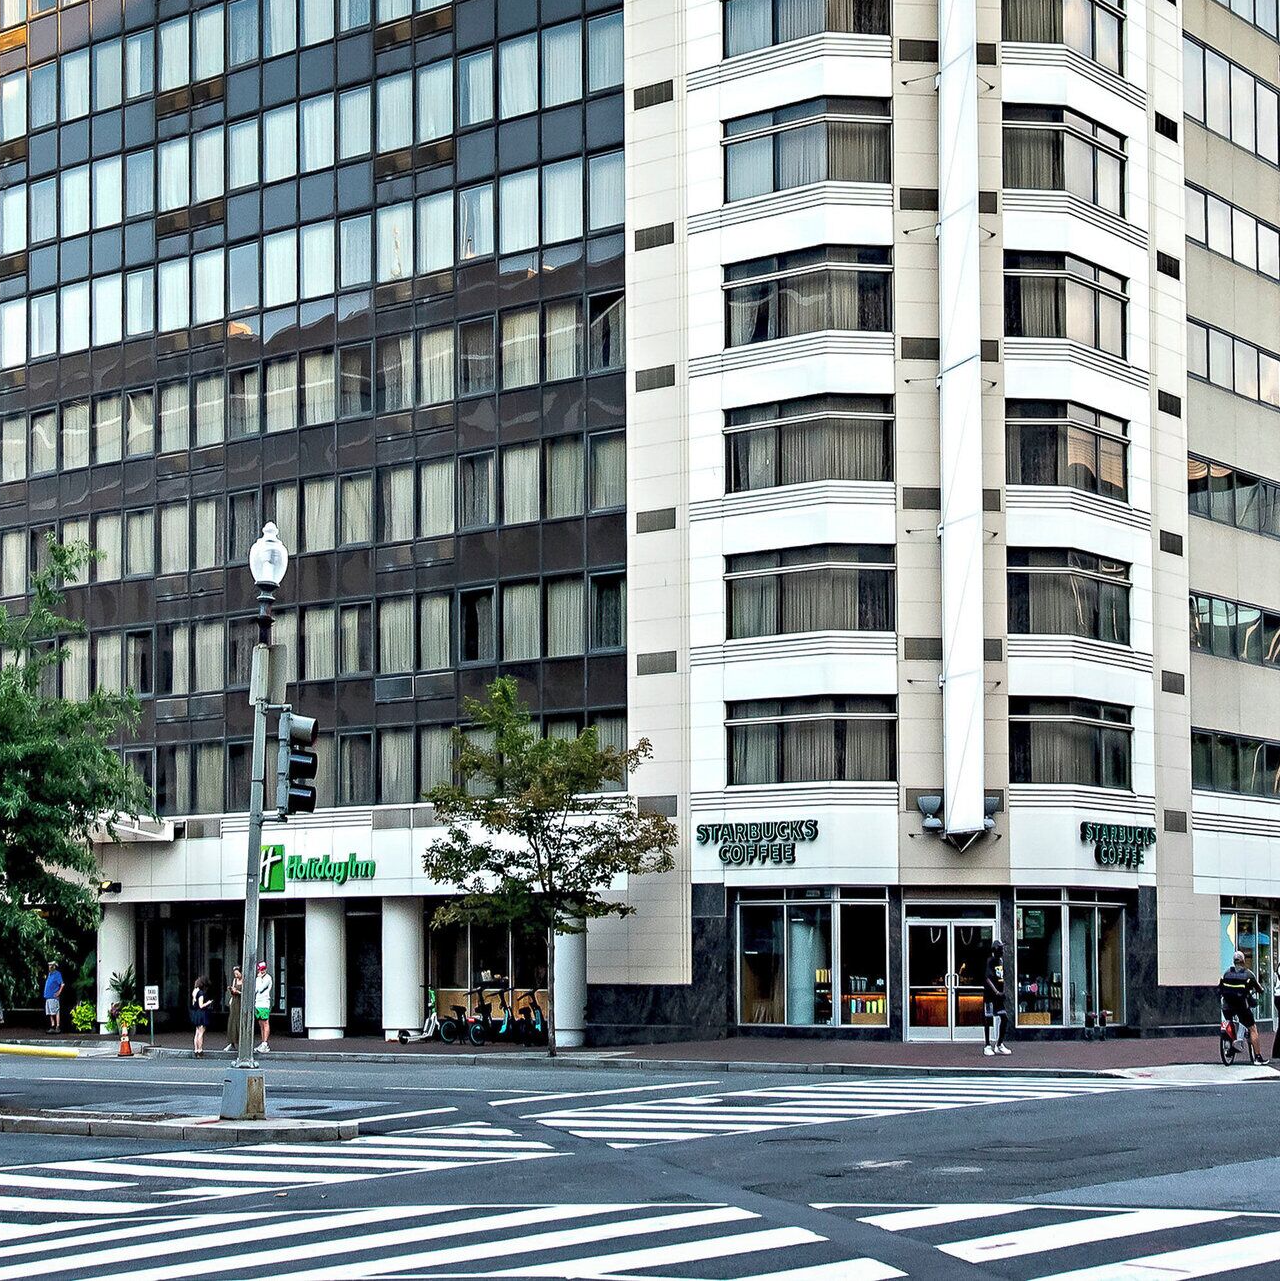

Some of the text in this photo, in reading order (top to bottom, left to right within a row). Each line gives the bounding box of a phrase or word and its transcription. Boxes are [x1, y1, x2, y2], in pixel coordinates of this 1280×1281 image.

[696, 820, 819, 846] STARBUCKS
[1080, 821, 1157, 847] STARBUCKS
[719, 843, 797, 866] COFFEE
[1094, 844, 1145, 869] COFFEE
[286, 855, 348, 885] Holiday
[347, 853, 376, 879] Inn
